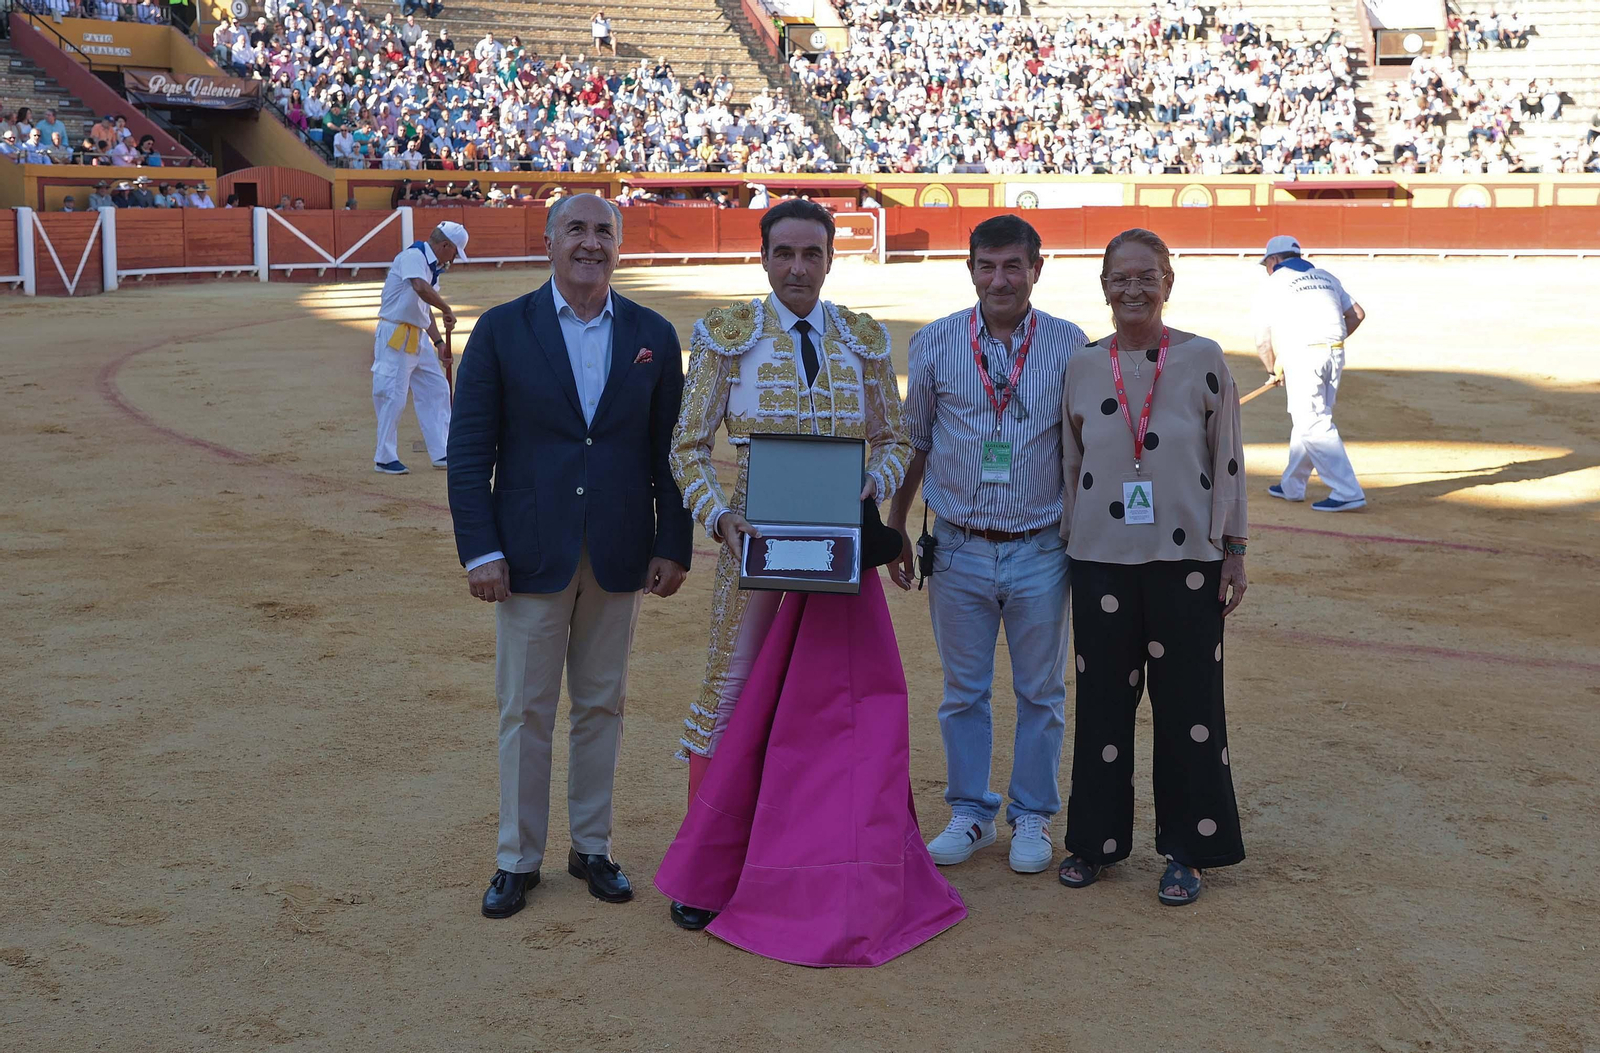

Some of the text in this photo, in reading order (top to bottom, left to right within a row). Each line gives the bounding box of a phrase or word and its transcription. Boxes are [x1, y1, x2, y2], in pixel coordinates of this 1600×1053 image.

[83, 33, 113, 43] PATIO
[814, 36, 823, 44] 11
[149, 75, 242, 98] Pepe Valencia
